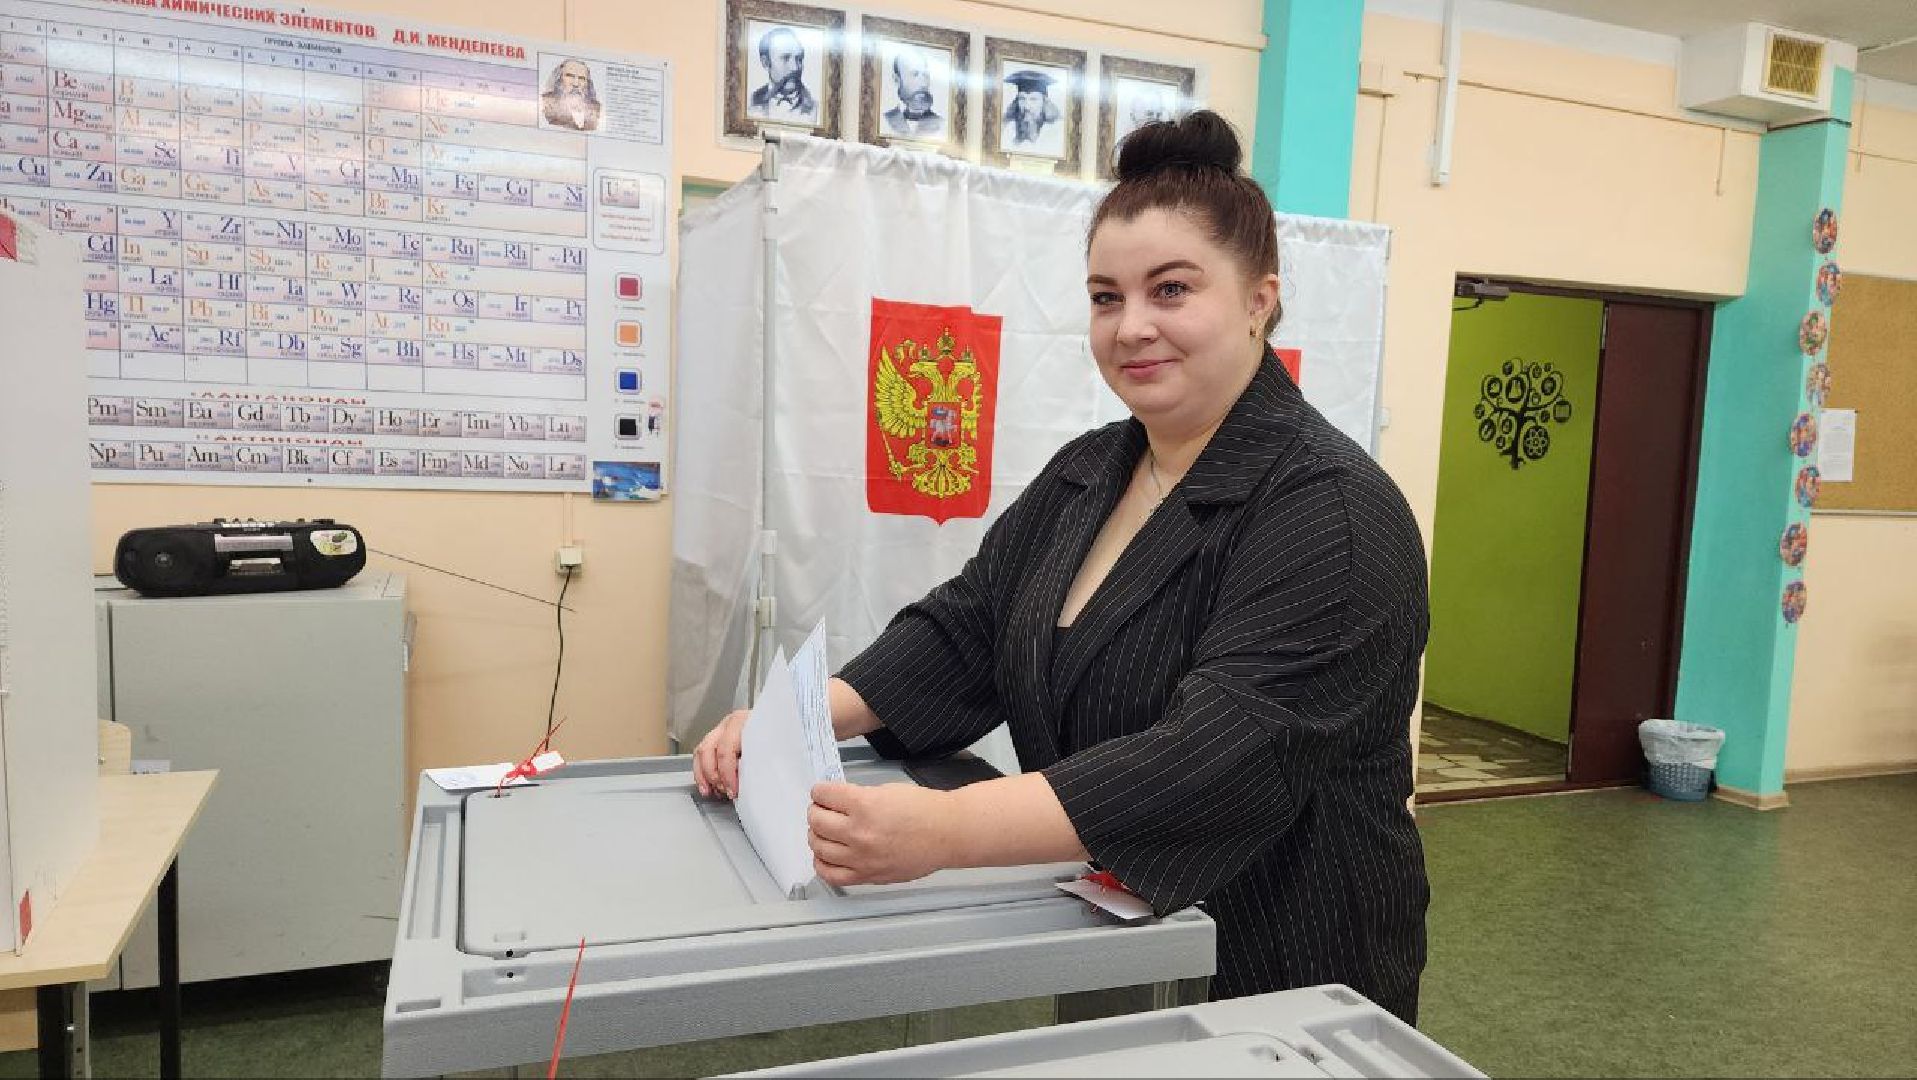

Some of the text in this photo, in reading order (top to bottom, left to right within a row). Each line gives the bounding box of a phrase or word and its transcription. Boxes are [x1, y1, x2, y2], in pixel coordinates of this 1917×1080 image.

[160, 0, 276, 24] ХИМИЧЕСКИХ
[280, 13, 376, 38] ЭЛЕМЕНТОВ
[427, 33, 526, 60] МЕНДЕЛЕЕВА
[54, 70, 78, 89] Be
[54, 100, 85, 125] Mg
[53, 130, 78, 150] Ca
[154, 141, 176, 159] Sc
[221, 147, 240, 165] Ti
[19, 157, 46, 176] Cu
[87, 163, 113, 182] Zn
[339, 160, 361, 178] Cr
[121, 168, 145, 185] Ga
[184, 174, 209, 191] Ge
[391, 167, 418, 185] Mn
[455, 174, 474, 191] Fe
[506, 179, 528, 195] Co
[565, 185, 584, 202] Ni
[370, 192, 389, 209] Br
[427, 198, 445, 214] Kr
[54, 202, 76, 221] Sr
[162, 211, 177, 228] Y
[220, 216, 242, 234] Zr
[276, 220, 303, 239] Nb
[87, 235, 114, 253] Cd
[335, 226, 362, 245] Mo
[397, 232, 420, 250] Tc
[123, 237, 140, 255] In
[186, 243, 209, 261] Sn
[451, 238, 474, 255] Ru
[504, 242, 526, 260] Rh
[250, 248, 272, 265] Sb
[311, 252, 331, 270] Te
[563, 247, 582, 264] Pd
[151, 267, 173, 285] La
[217, 273, 239, 291] Hf
[283, 278, 303, 296] Ta
[341, 282, 362, 299] W
[399, 286, 420, 304] Re
[87, 292, 116, 316] Hg
[452, 290, 474, 308] Os
[515, 295, 528, 311] Ir
[189, 299, 213, 317] Pb
[252, 303, 269, 320] Bi
[313, 307, 335, 324] Po
[565, 300, 583, 316] Pt
[428, 315, 450, 332] Rn
[145, 325, 170, 342] Ac
[219, 330, 241, 347] Rf
[278, 333, 305, 350] Db
[340, 337, 363, 357] Sg
[397, 340, 420, 357] Bh
[452, 343, 475, 360] Hs
[505, 346, 526, 363] Mt
[562, 350, 583, 367] Ds
[88, 397, 118, 417] Pm
[136, 400, 168, 418] Sm
[189, 401, 213, 420] Eu
[237, 404, 264, 421] Gd
[286, 406, 311, 423] Tb
[332, 408, 357, 426] Dy
[378, 409, 403, 427] Ho
[421, 412, 441, 429] Er
[463, 413, 490, 430] Tm
[508, 415, 529, 432] Yb
[549, 416, 570, 432] Lu
[89, 442, 117, 463] Np
[140, 443, 165, 461] Pu
[187, 446, 220, 463] Am
[236, 446, 268, 465] Cm
[287, 448, 309, 466] Bk
[332, 450, 354, 466] Cf
[379, 451, 399, 467] Es
[421, 452, 448, 469] Fm
[463, 454, 489, 471] Md
[508, 455, 529, 471] No
[549, 455, 567, 472] Lr
